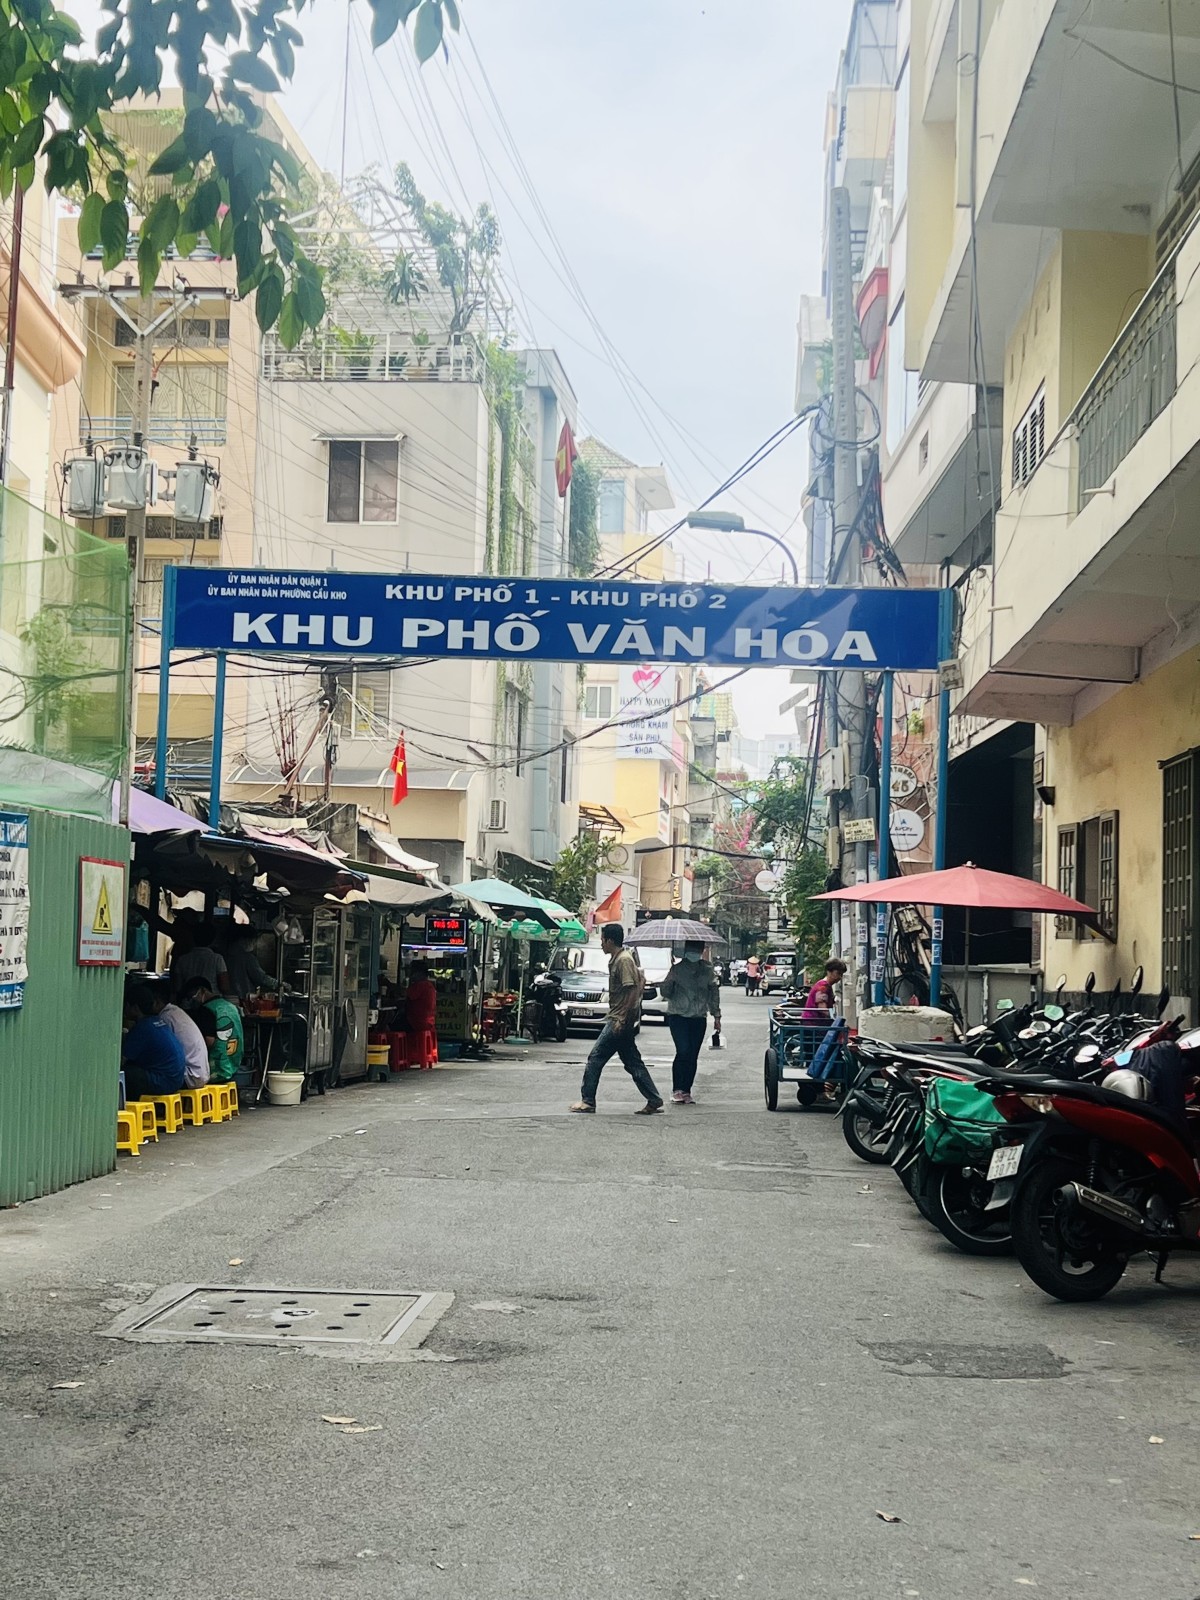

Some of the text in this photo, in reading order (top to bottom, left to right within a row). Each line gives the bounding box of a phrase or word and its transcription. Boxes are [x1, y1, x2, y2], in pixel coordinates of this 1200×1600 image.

[228, 573, 328, 588] ỦY BAN NHÂN DÂN QUẬN 1
[207, 586, 219, 597] ỦY
[220, 587, 237, 597] BAN
[238, 586, 260, 598] NHÂN
[261, 587, 278, 598] DÂN
[280, 587, 311, 599] PHƯỜNG
[330, 591, 347, 600] KHO
[385, 584, 443, 600] KHU
[454, 582, 516, 603] PHỐ
[525, 589, 539, 603] 1
[570, 590, 629, 606] KHU
[640, 588, 702, 607] PHỐ
[708, 594, 727, 609] 2
[233, 610, 878, 662] KHU PHỐ VĂN HÓA
[620, 697, 671, 706] HAPPY MOMMY
[634, 746, 653, 755] KHOA
